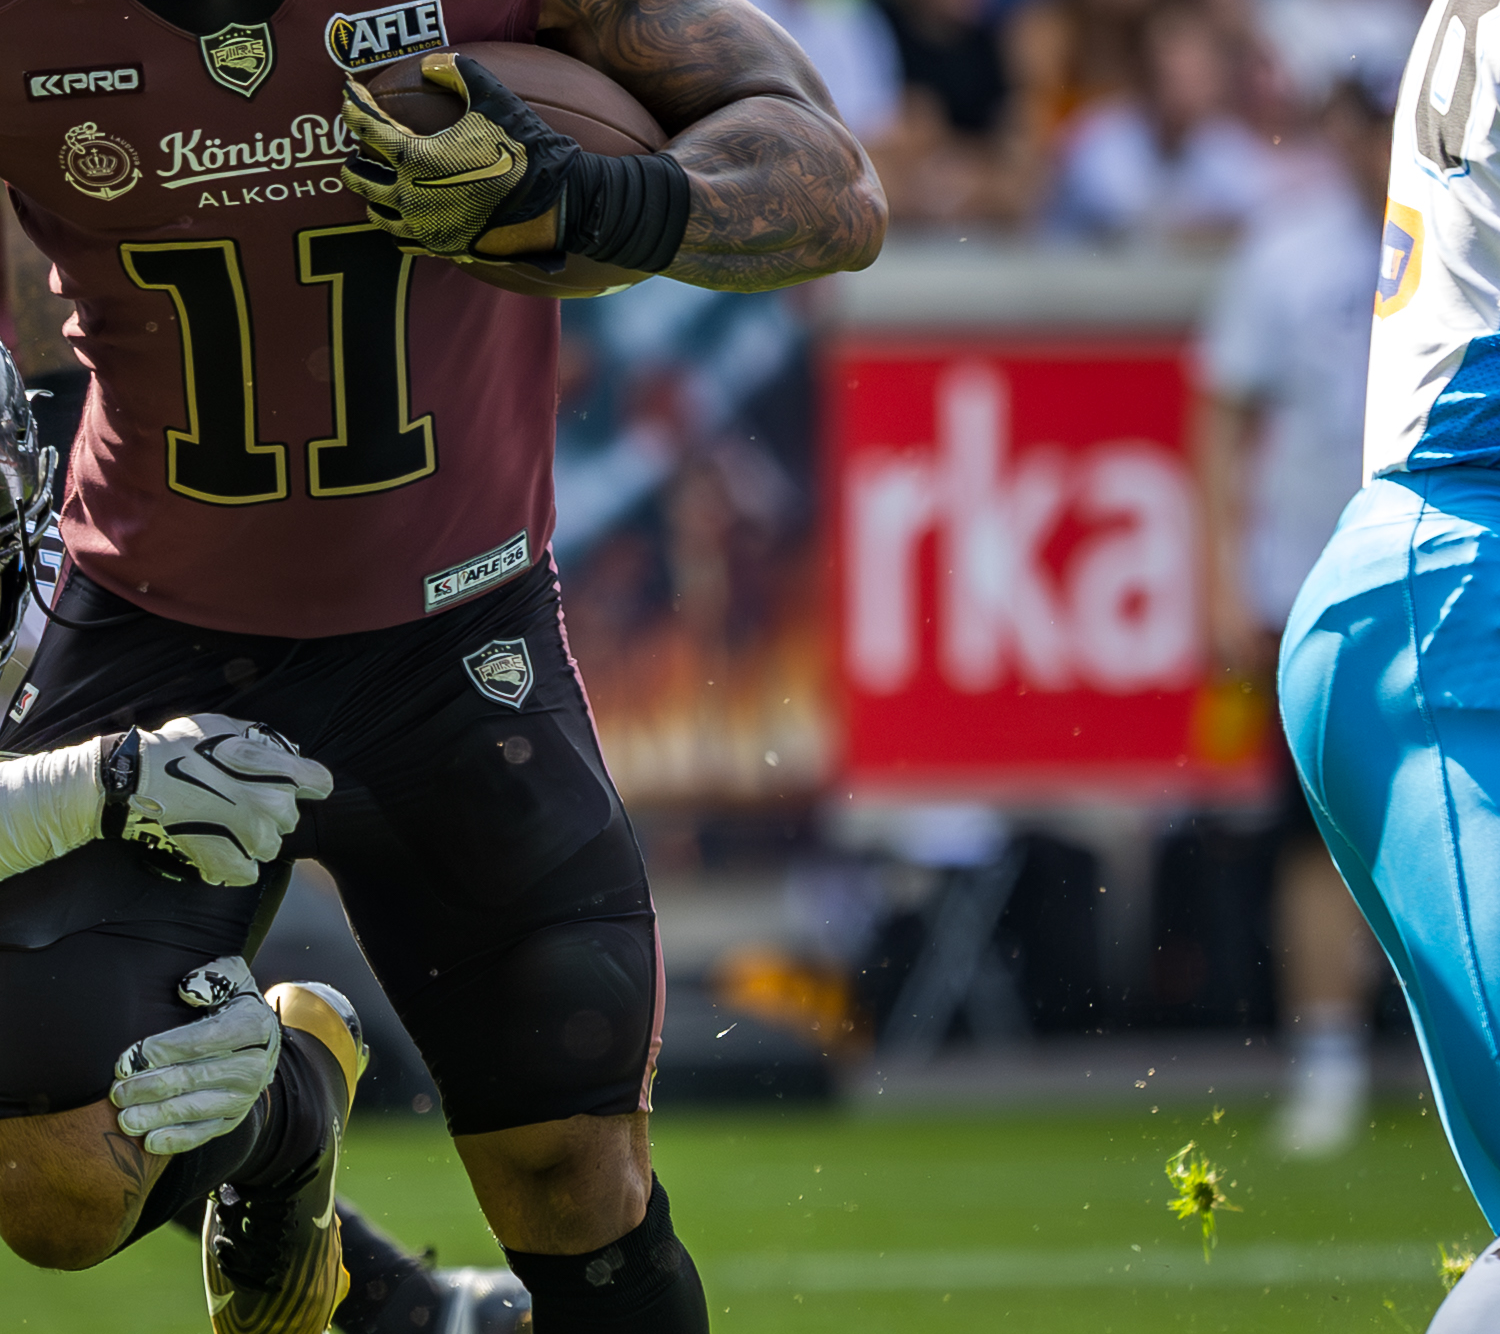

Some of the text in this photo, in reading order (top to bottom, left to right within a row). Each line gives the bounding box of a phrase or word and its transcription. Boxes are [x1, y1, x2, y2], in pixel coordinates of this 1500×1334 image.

[350, 4, 440, 59] AFLE
[350, 39, 443, 67] THE LEAGUE EUROPE
[198, 177, 344, 208] ALKOHO
[120, 222, 436, 507] 11
[465, 558, 500, 585] AFLE
